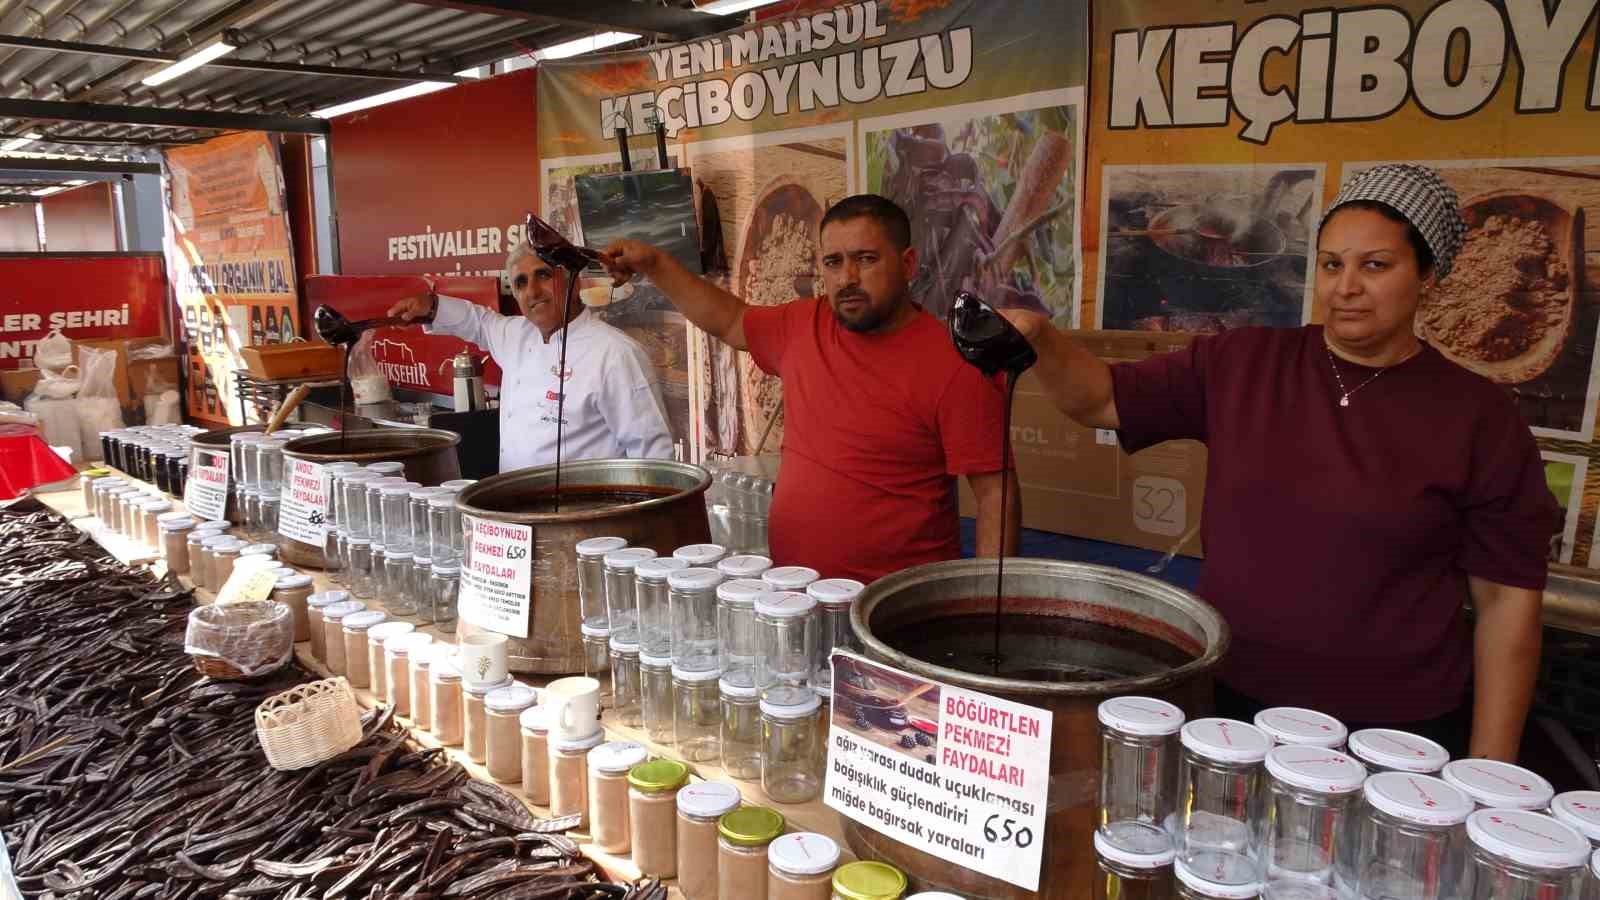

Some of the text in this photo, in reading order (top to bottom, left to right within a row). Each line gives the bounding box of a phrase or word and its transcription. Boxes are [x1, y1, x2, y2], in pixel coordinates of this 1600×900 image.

[600, 27, 973, 140] KEÇİBOYNUZU
[1107, 0, 1600, 145] KEÇİBOY
[388, 225, 502, 261] FESTİVALLER
[1009, 426, 1049, 445] TCL
[473, 560, 516, 580] FAYDALARI
[474, 541, 527, 559] PEKMEZİ 650
[945, 695, 1041, 738] BÖĞÜRTLEN
[944, 722, 1011, 757] PEKMEZİ
[836, 735, 858, 752] ağız
[899, 761, 941, 788] dudak
[945, 778, 1036, 817] uçuklaması
[943, 747, 1025, 788] FAYDALARI
[834, 758, 968, 825] bağışıklık güçlendiriri
[868, 801, 923, 838] bağırsak
[927, 828, 985, 860] yaraları
[984, 814, 1033, 849] 650
